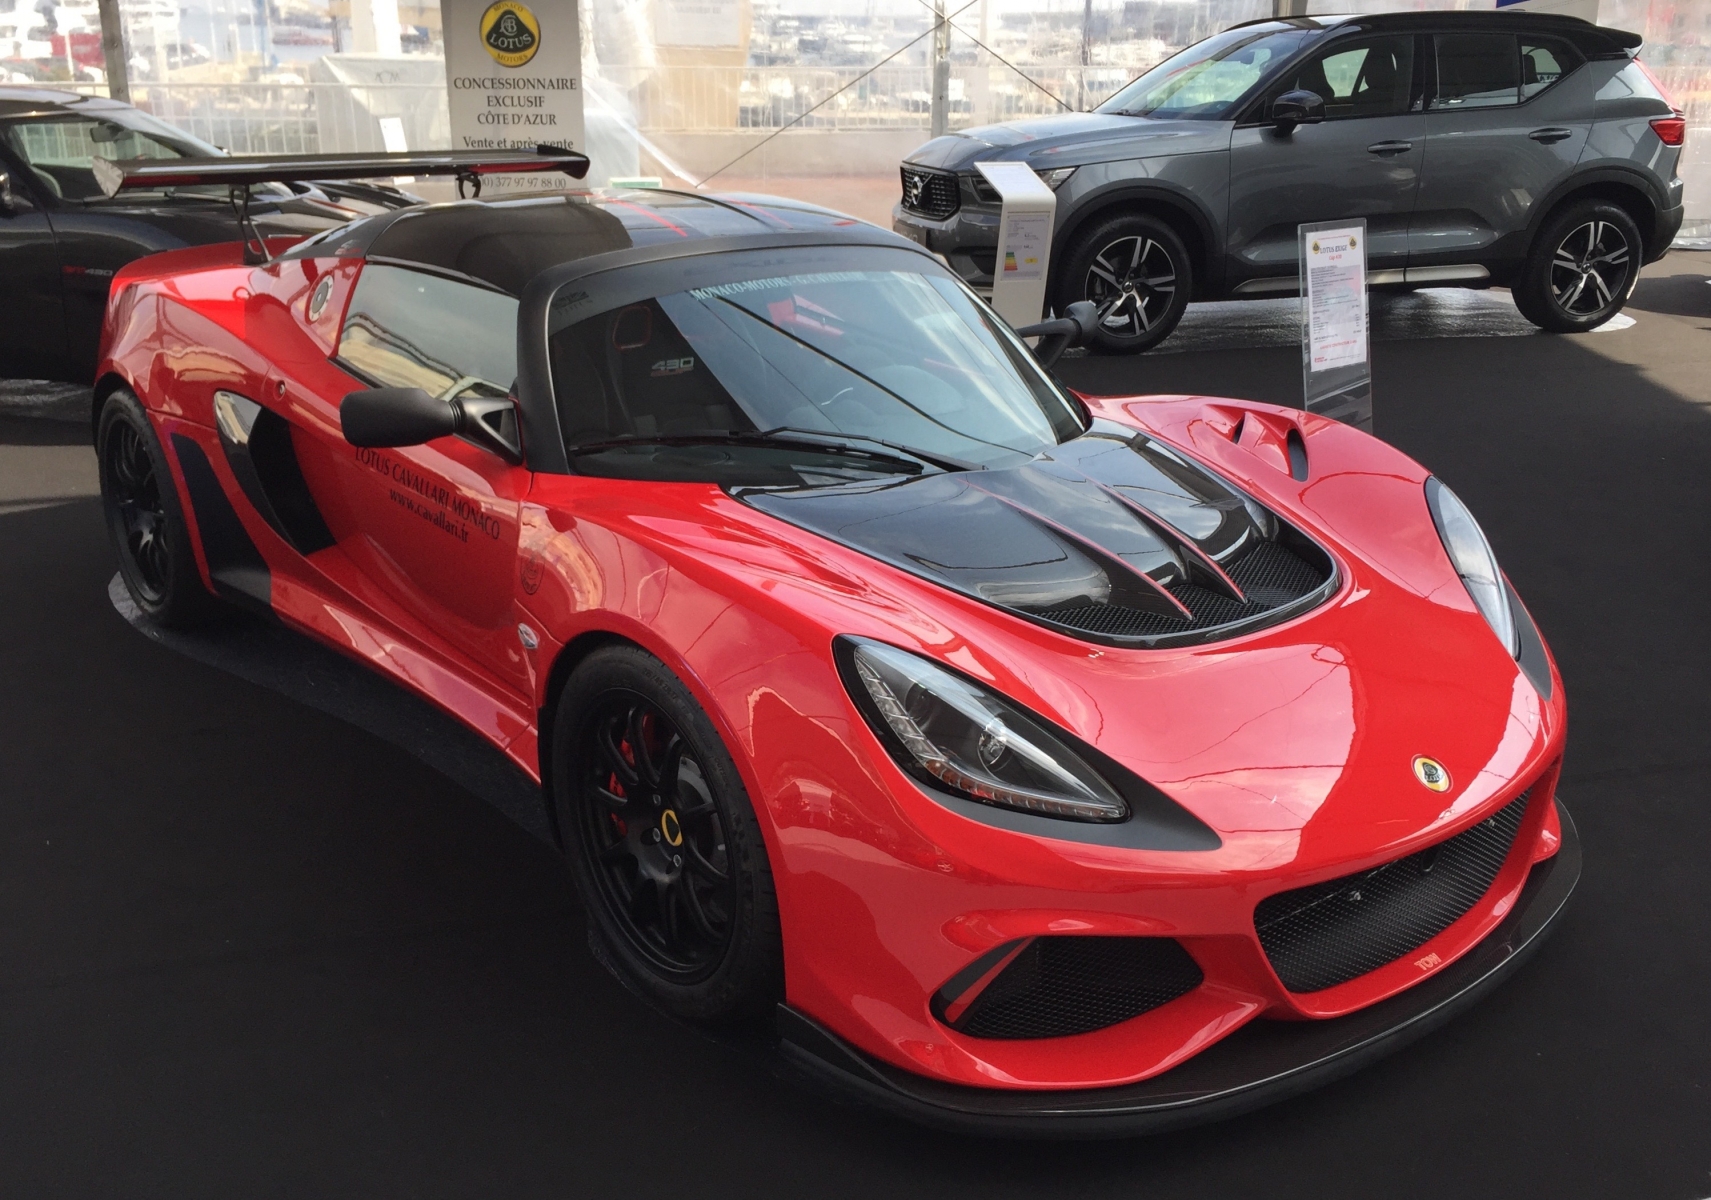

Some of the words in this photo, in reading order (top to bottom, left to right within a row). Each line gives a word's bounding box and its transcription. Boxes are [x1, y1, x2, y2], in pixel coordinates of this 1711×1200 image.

[490, 33, 532, 49] LOTUS
[453, 77, 577, 90] CONCESSIONNAIRE
[486, 95, 546, 108] EXCLUSIF
[477, 110, 510, 125] CÔTE
[511, 113, 557, 126] D'AZUR
[463, 136, 493, 148] Vente
[497, 138, 507, 148] et
[496, 177, 512, 188] 377
[514, 177, 526, 188] 97
[528, 178, 539, 188] 97
[541, 178, 552, 188] 88
[554, 178, 567, 189] 00
[355, 446, 390, 476] LOTUS
[392, 463, 450, 509] CAVALLARI
[452, 496, 500, 540] MONACO
[389, 488, 469, 543] www.cavallari.fr
[1413, 952, 1442, 971] TOW
